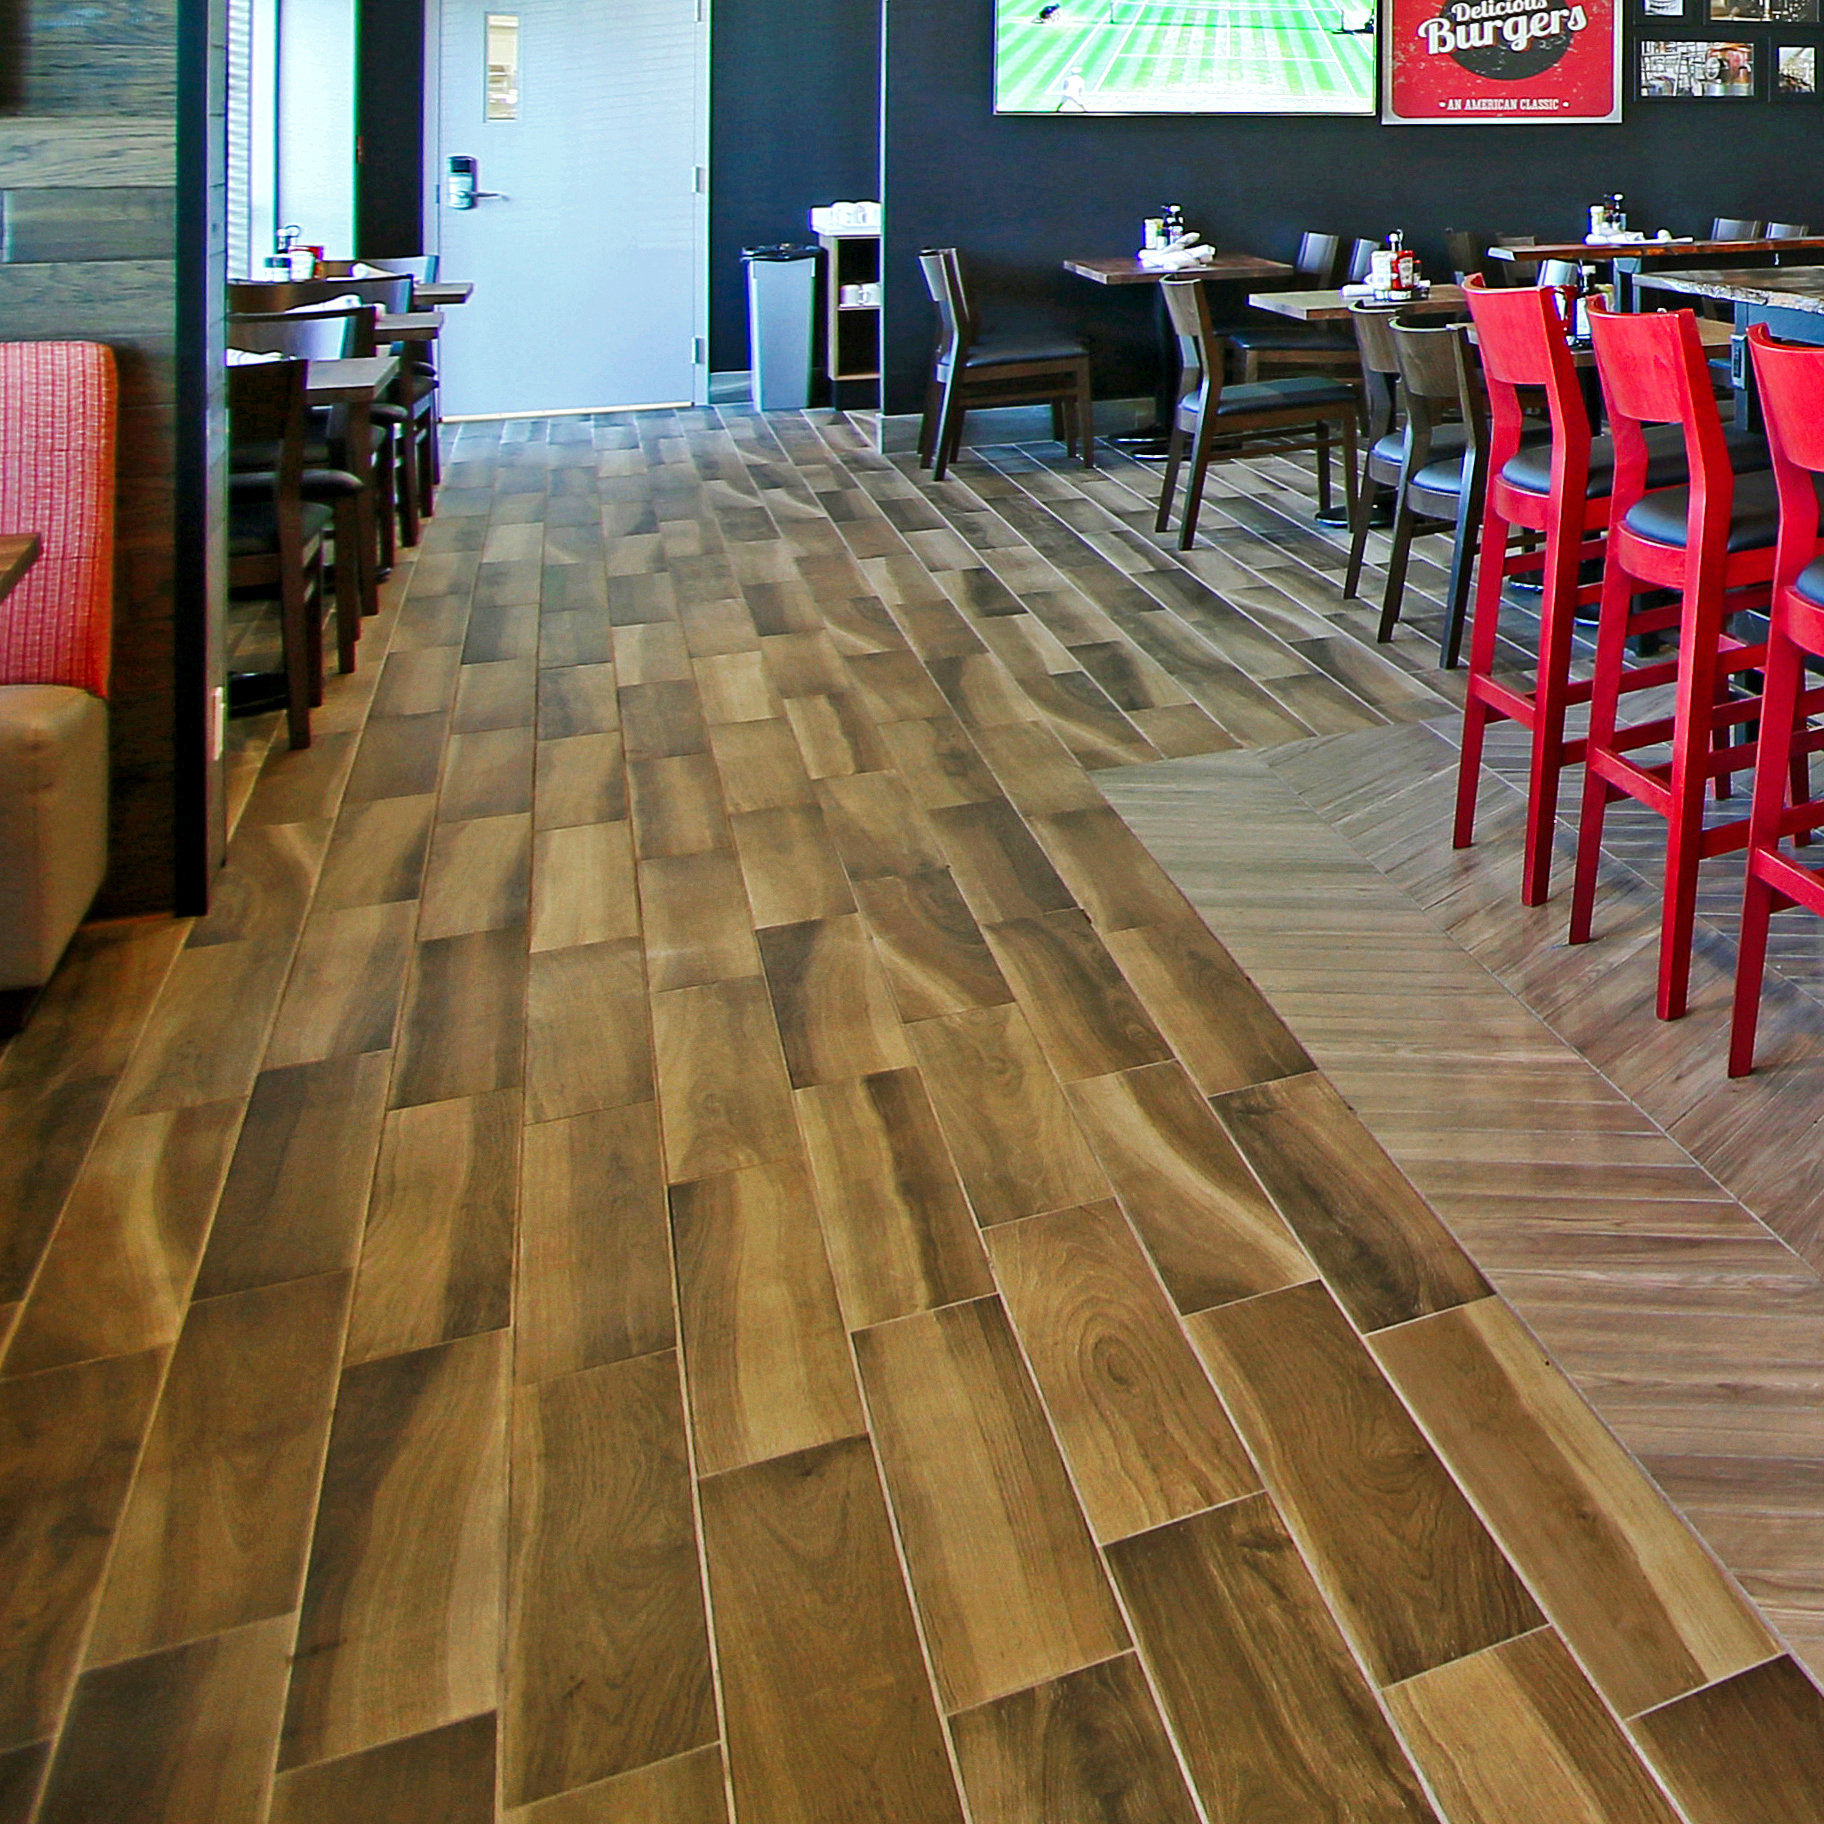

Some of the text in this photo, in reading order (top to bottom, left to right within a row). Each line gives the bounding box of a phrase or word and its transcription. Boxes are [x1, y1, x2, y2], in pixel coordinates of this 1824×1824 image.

[1417, 5, 1588, 55] Burgers
[1447, 99, 1559, 111] AN AMERICAN CLASSIC
